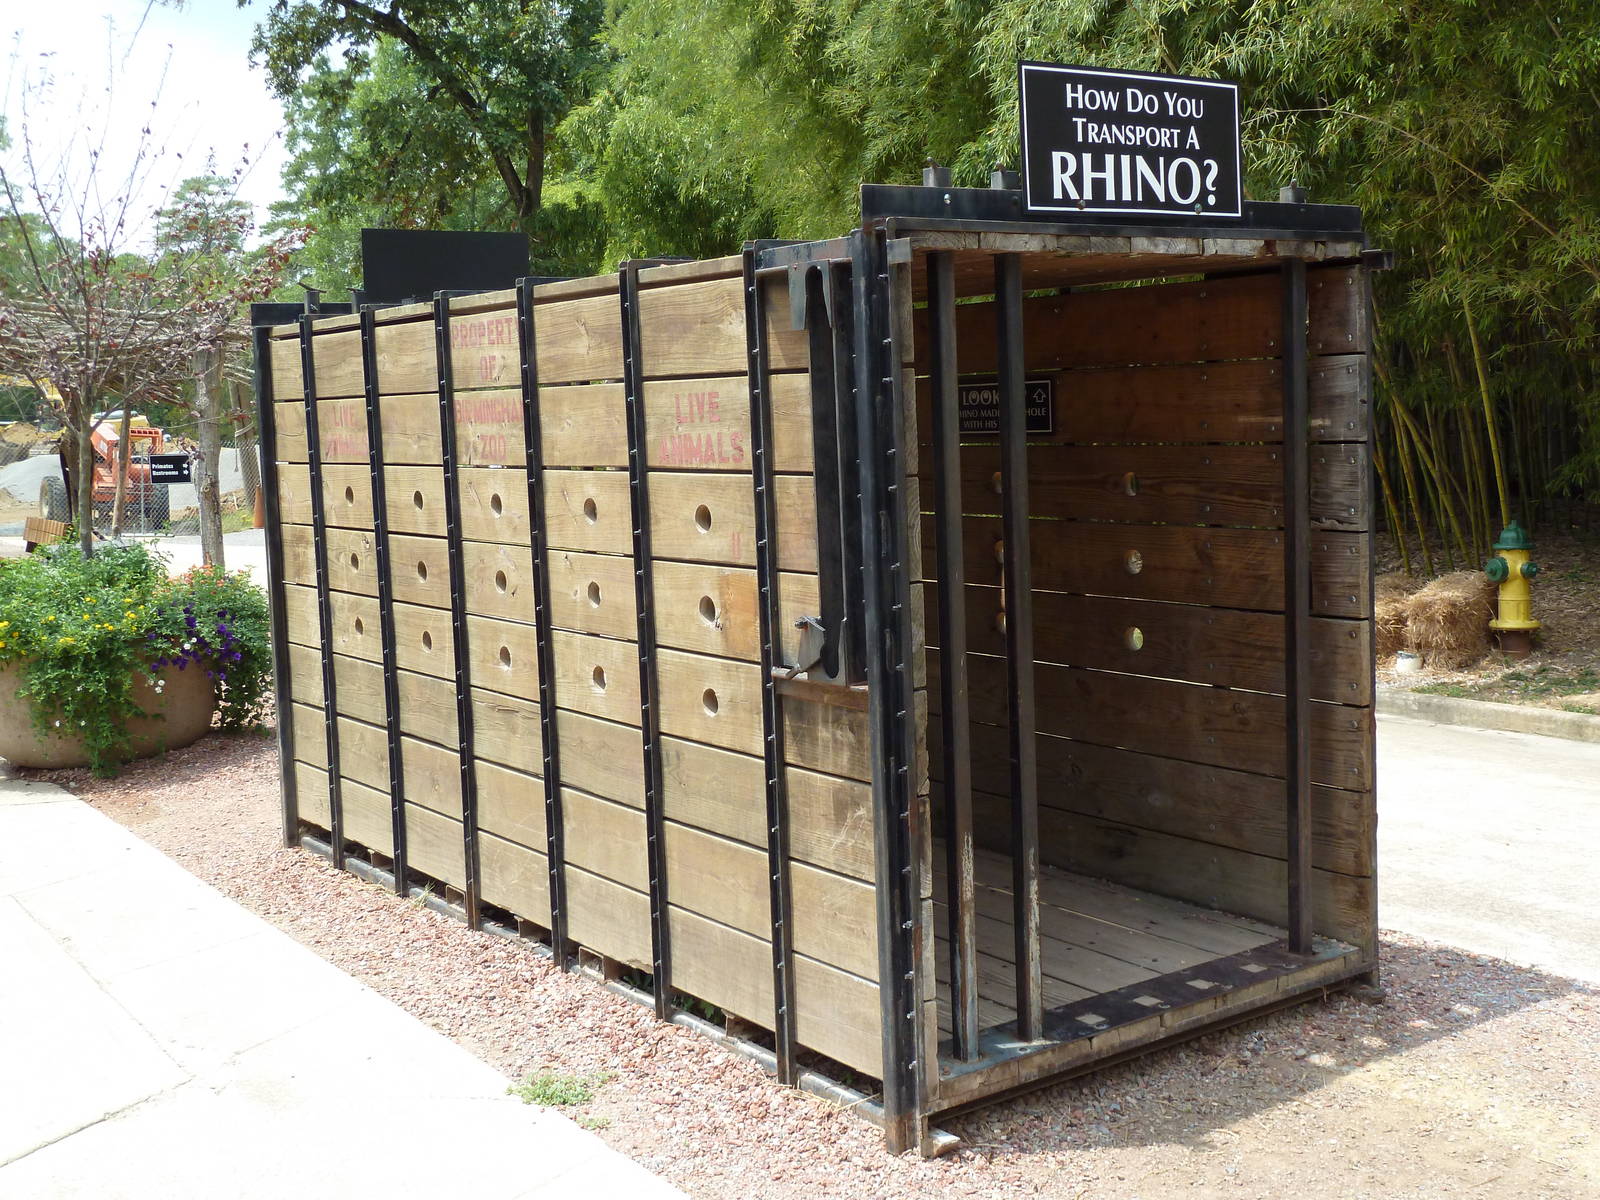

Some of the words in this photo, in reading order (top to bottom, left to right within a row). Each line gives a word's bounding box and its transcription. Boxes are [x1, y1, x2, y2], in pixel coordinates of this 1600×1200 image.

[1186, 125, 1201, 150] A
[1051, 150, 1219, 206] RHINO?
[451, 316, 519, 348] PROPERT
[480, 355, 497, 381] OF
[675, 391, 721, 424] LIVE
[480, 434, 506, 461] ZOO
[658, 431, 745, 465] ANIMALS
